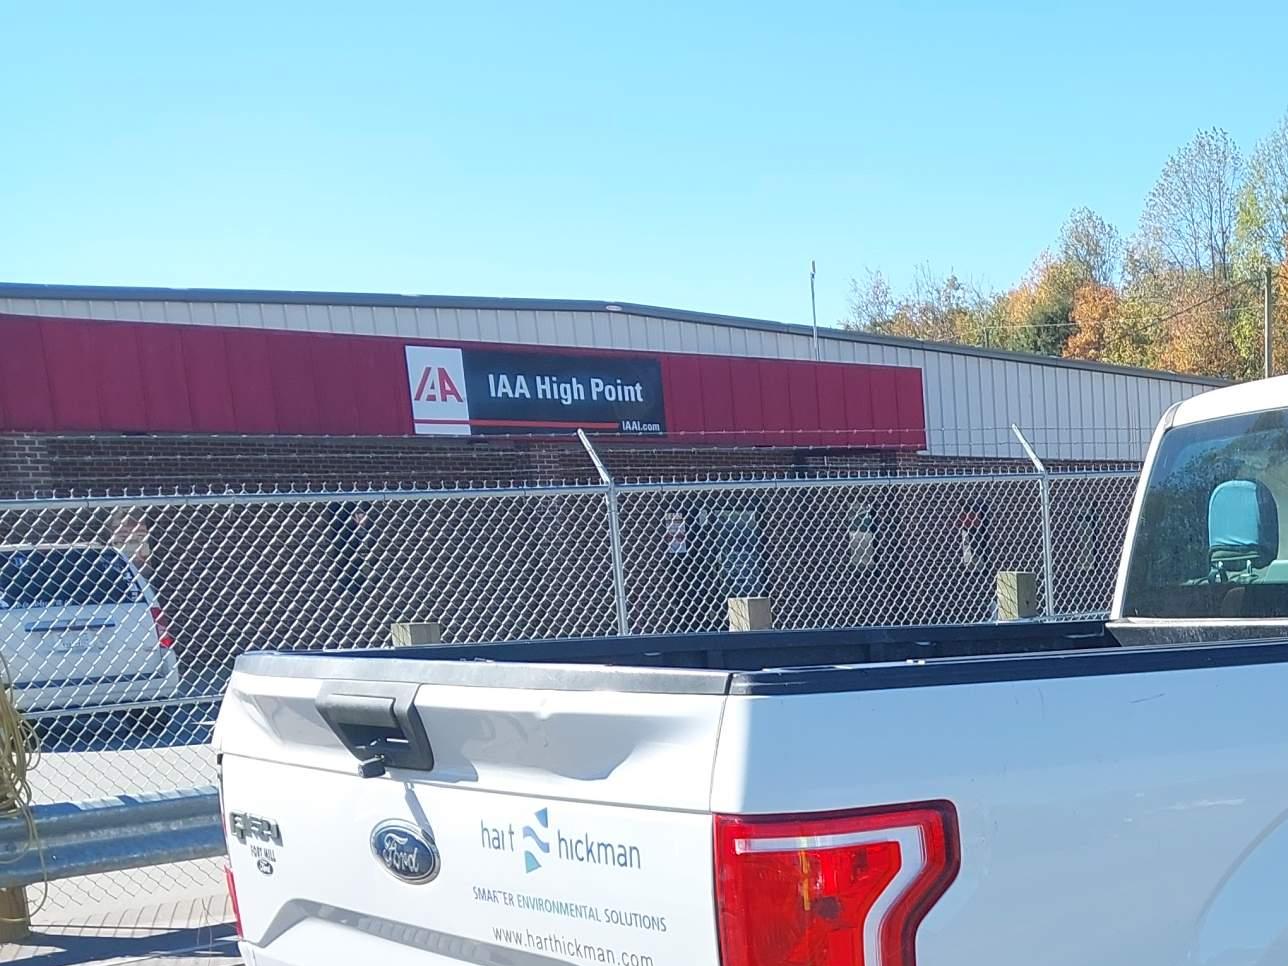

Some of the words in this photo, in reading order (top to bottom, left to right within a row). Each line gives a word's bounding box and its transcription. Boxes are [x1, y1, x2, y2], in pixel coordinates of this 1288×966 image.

[488, 374, 531, 399] IAA
[536, 376, 585, 405] High
[591, 378, 644, 402] Point
[622, 420, 660, 432] IAAI.com
[383, 832, 420, 873] Ford
[557, 829, 641, 869] hickman
[516, 894, 601, 922] ENVIRONMENTAL
[604, 908, 667, 932] SOLUTIONS
